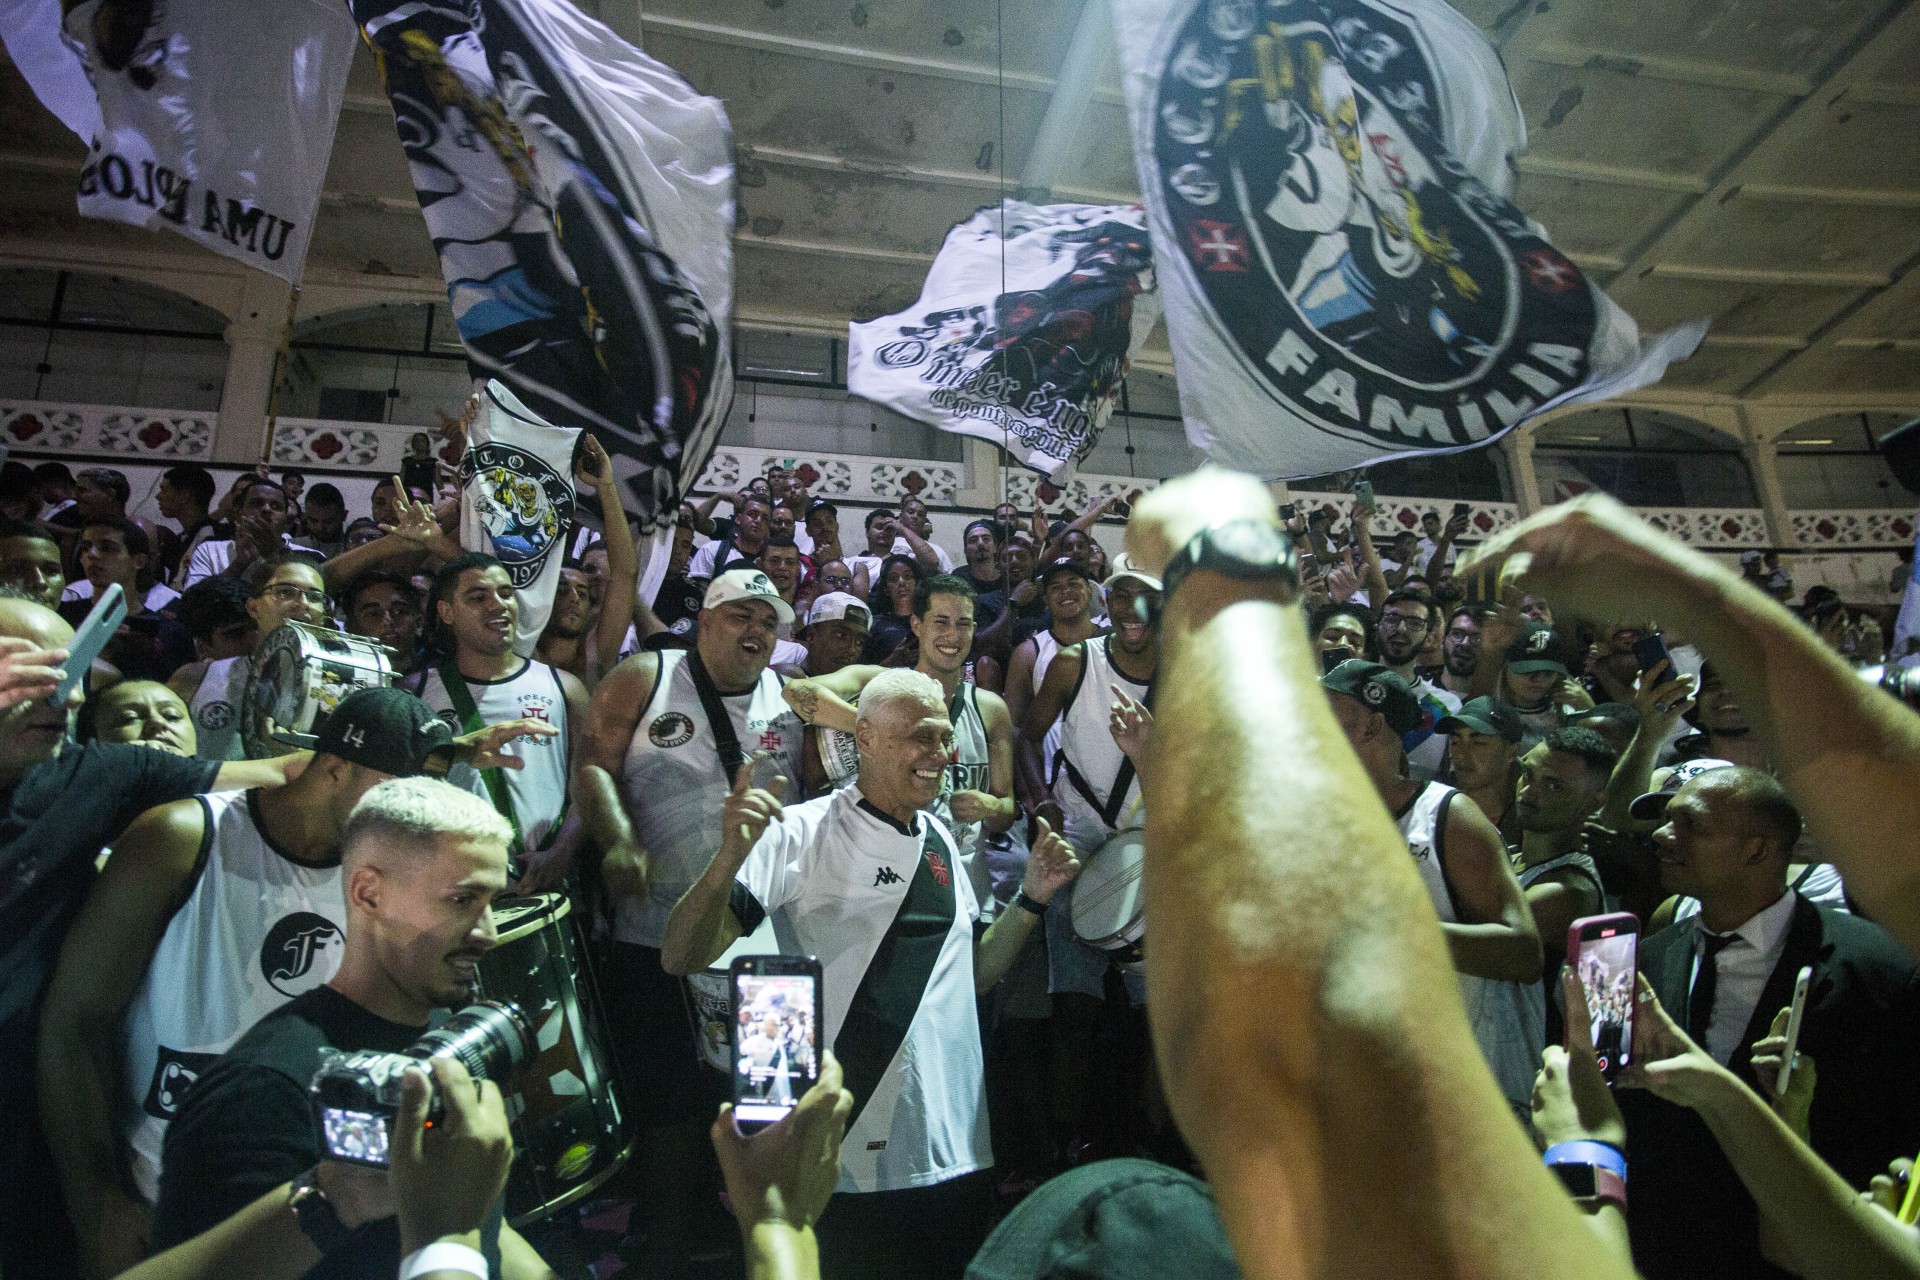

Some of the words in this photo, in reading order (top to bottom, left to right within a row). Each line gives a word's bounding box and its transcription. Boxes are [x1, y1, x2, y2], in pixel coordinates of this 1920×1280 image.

[1265, 330, 1585, 445] FAMÍLIA
[953, 396, 1013, 431] ponta
[1011, 419, 1031, 438] a
[342, 722, 366, 749] 14
